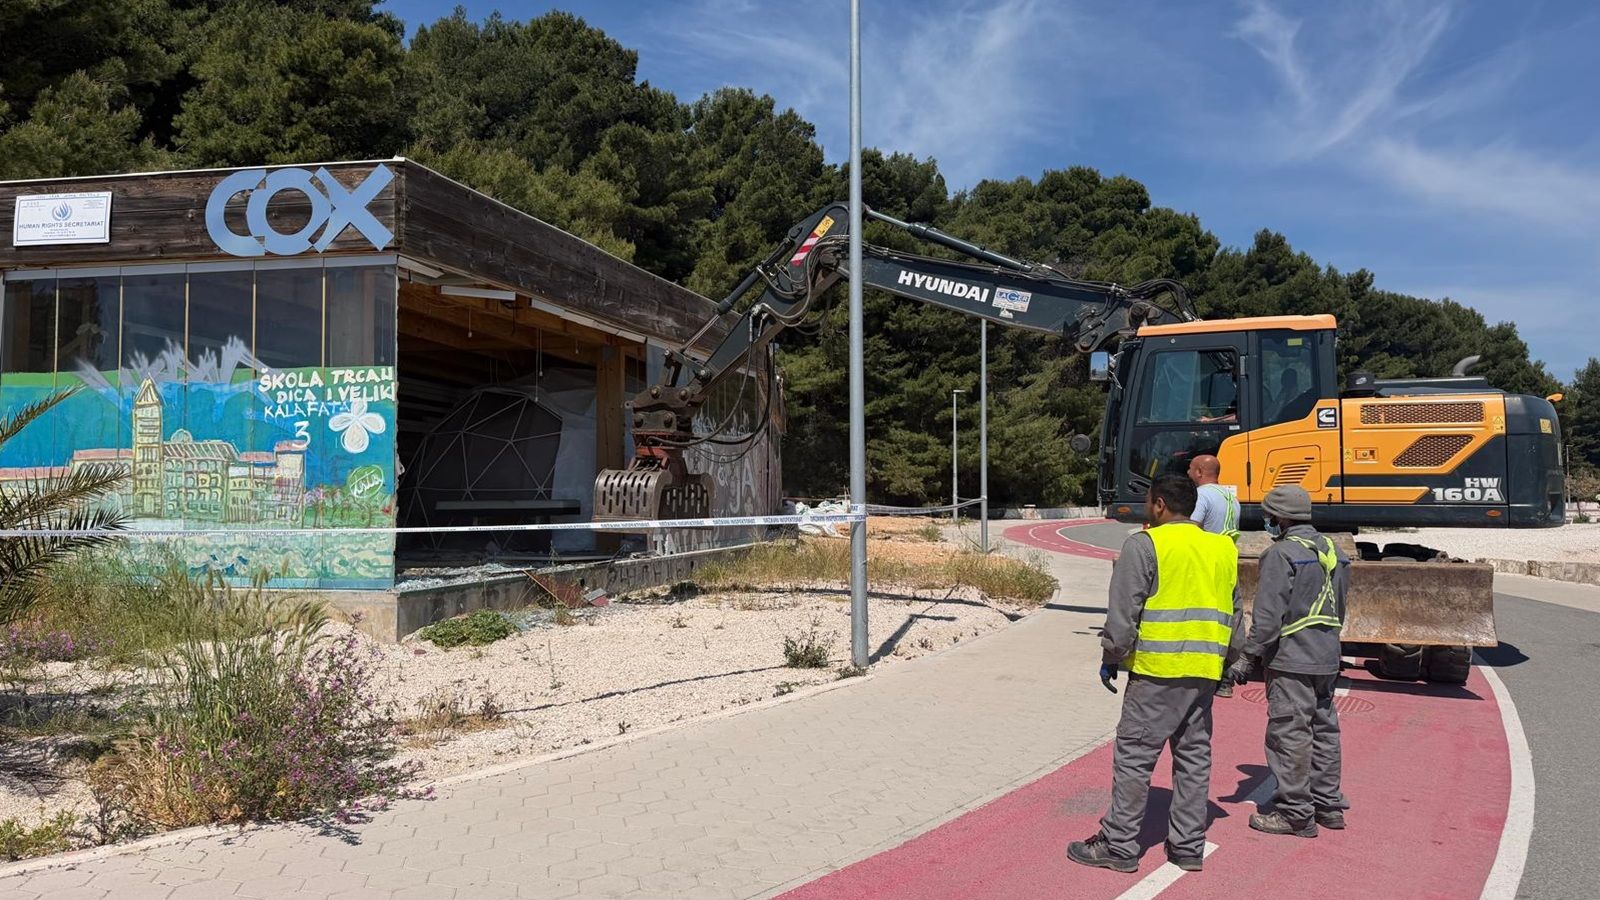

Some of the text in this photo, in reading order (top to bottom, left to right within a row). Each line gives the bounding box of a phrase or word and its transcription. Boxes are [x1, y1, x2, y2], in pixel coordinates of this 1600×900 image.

[205, 163, 394, 257] COX
[897, 270, 989, 303] HYUNDAI
[258, 368, 324, 392] ŠKOLA
[276, 388, 316, 403] DICA
[326, 387, 333, 401] I
[291, 420, 311, 448] 3
[1432, 487, 1502, 501] 160A
[1464, 477, 1499, 488] HW
